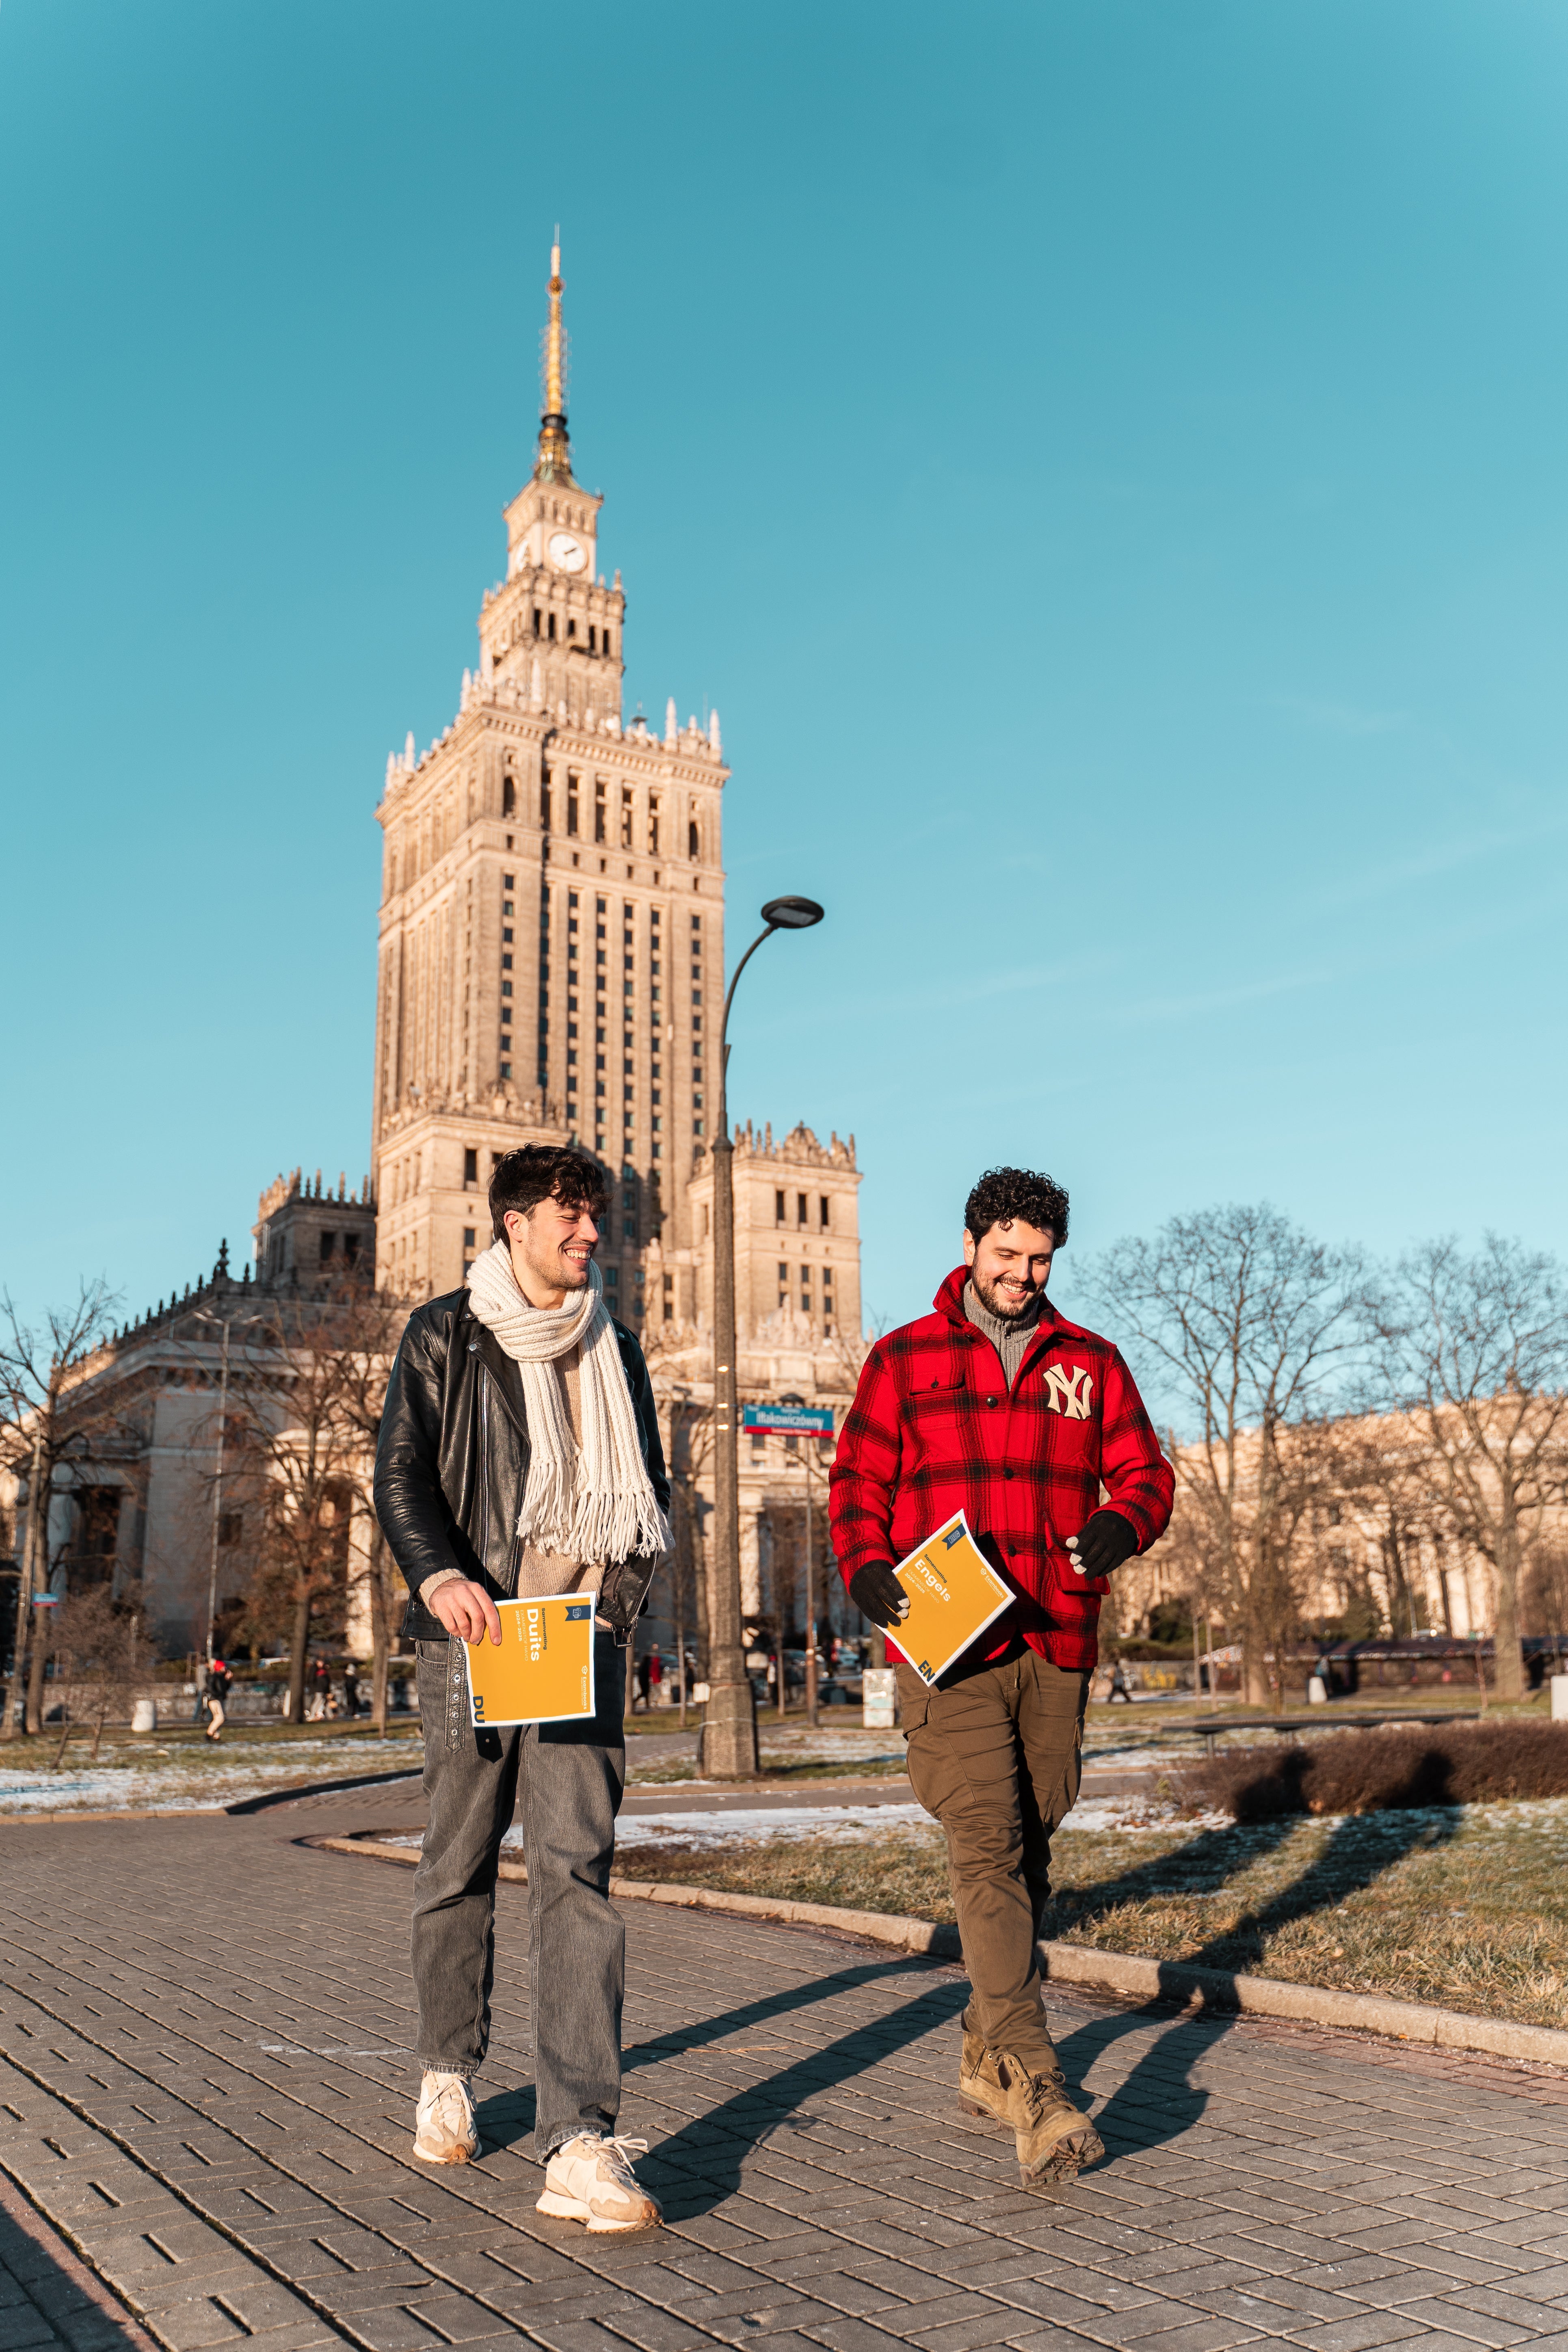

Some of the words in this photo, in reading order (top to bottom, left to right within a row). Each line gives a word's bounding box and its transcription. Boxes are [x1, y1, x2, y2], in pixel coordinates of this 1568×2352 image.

[1042, 1362, 1094, 1420] NY
[915, 1559, 951, 1602] Engels
[924, 1554, 947, 1583] Samenvatting
[908, 1569, 930, 1592] EXAMENSTOF
[929, 1592, 939, 1603] HAVO
[986, 1575, 1004, 1598] Exambooks
[527, 1608, 542, 1661] Duits
[918, 1660, 936, 1682] EN
[473, 1696, 485, 1723] DU
